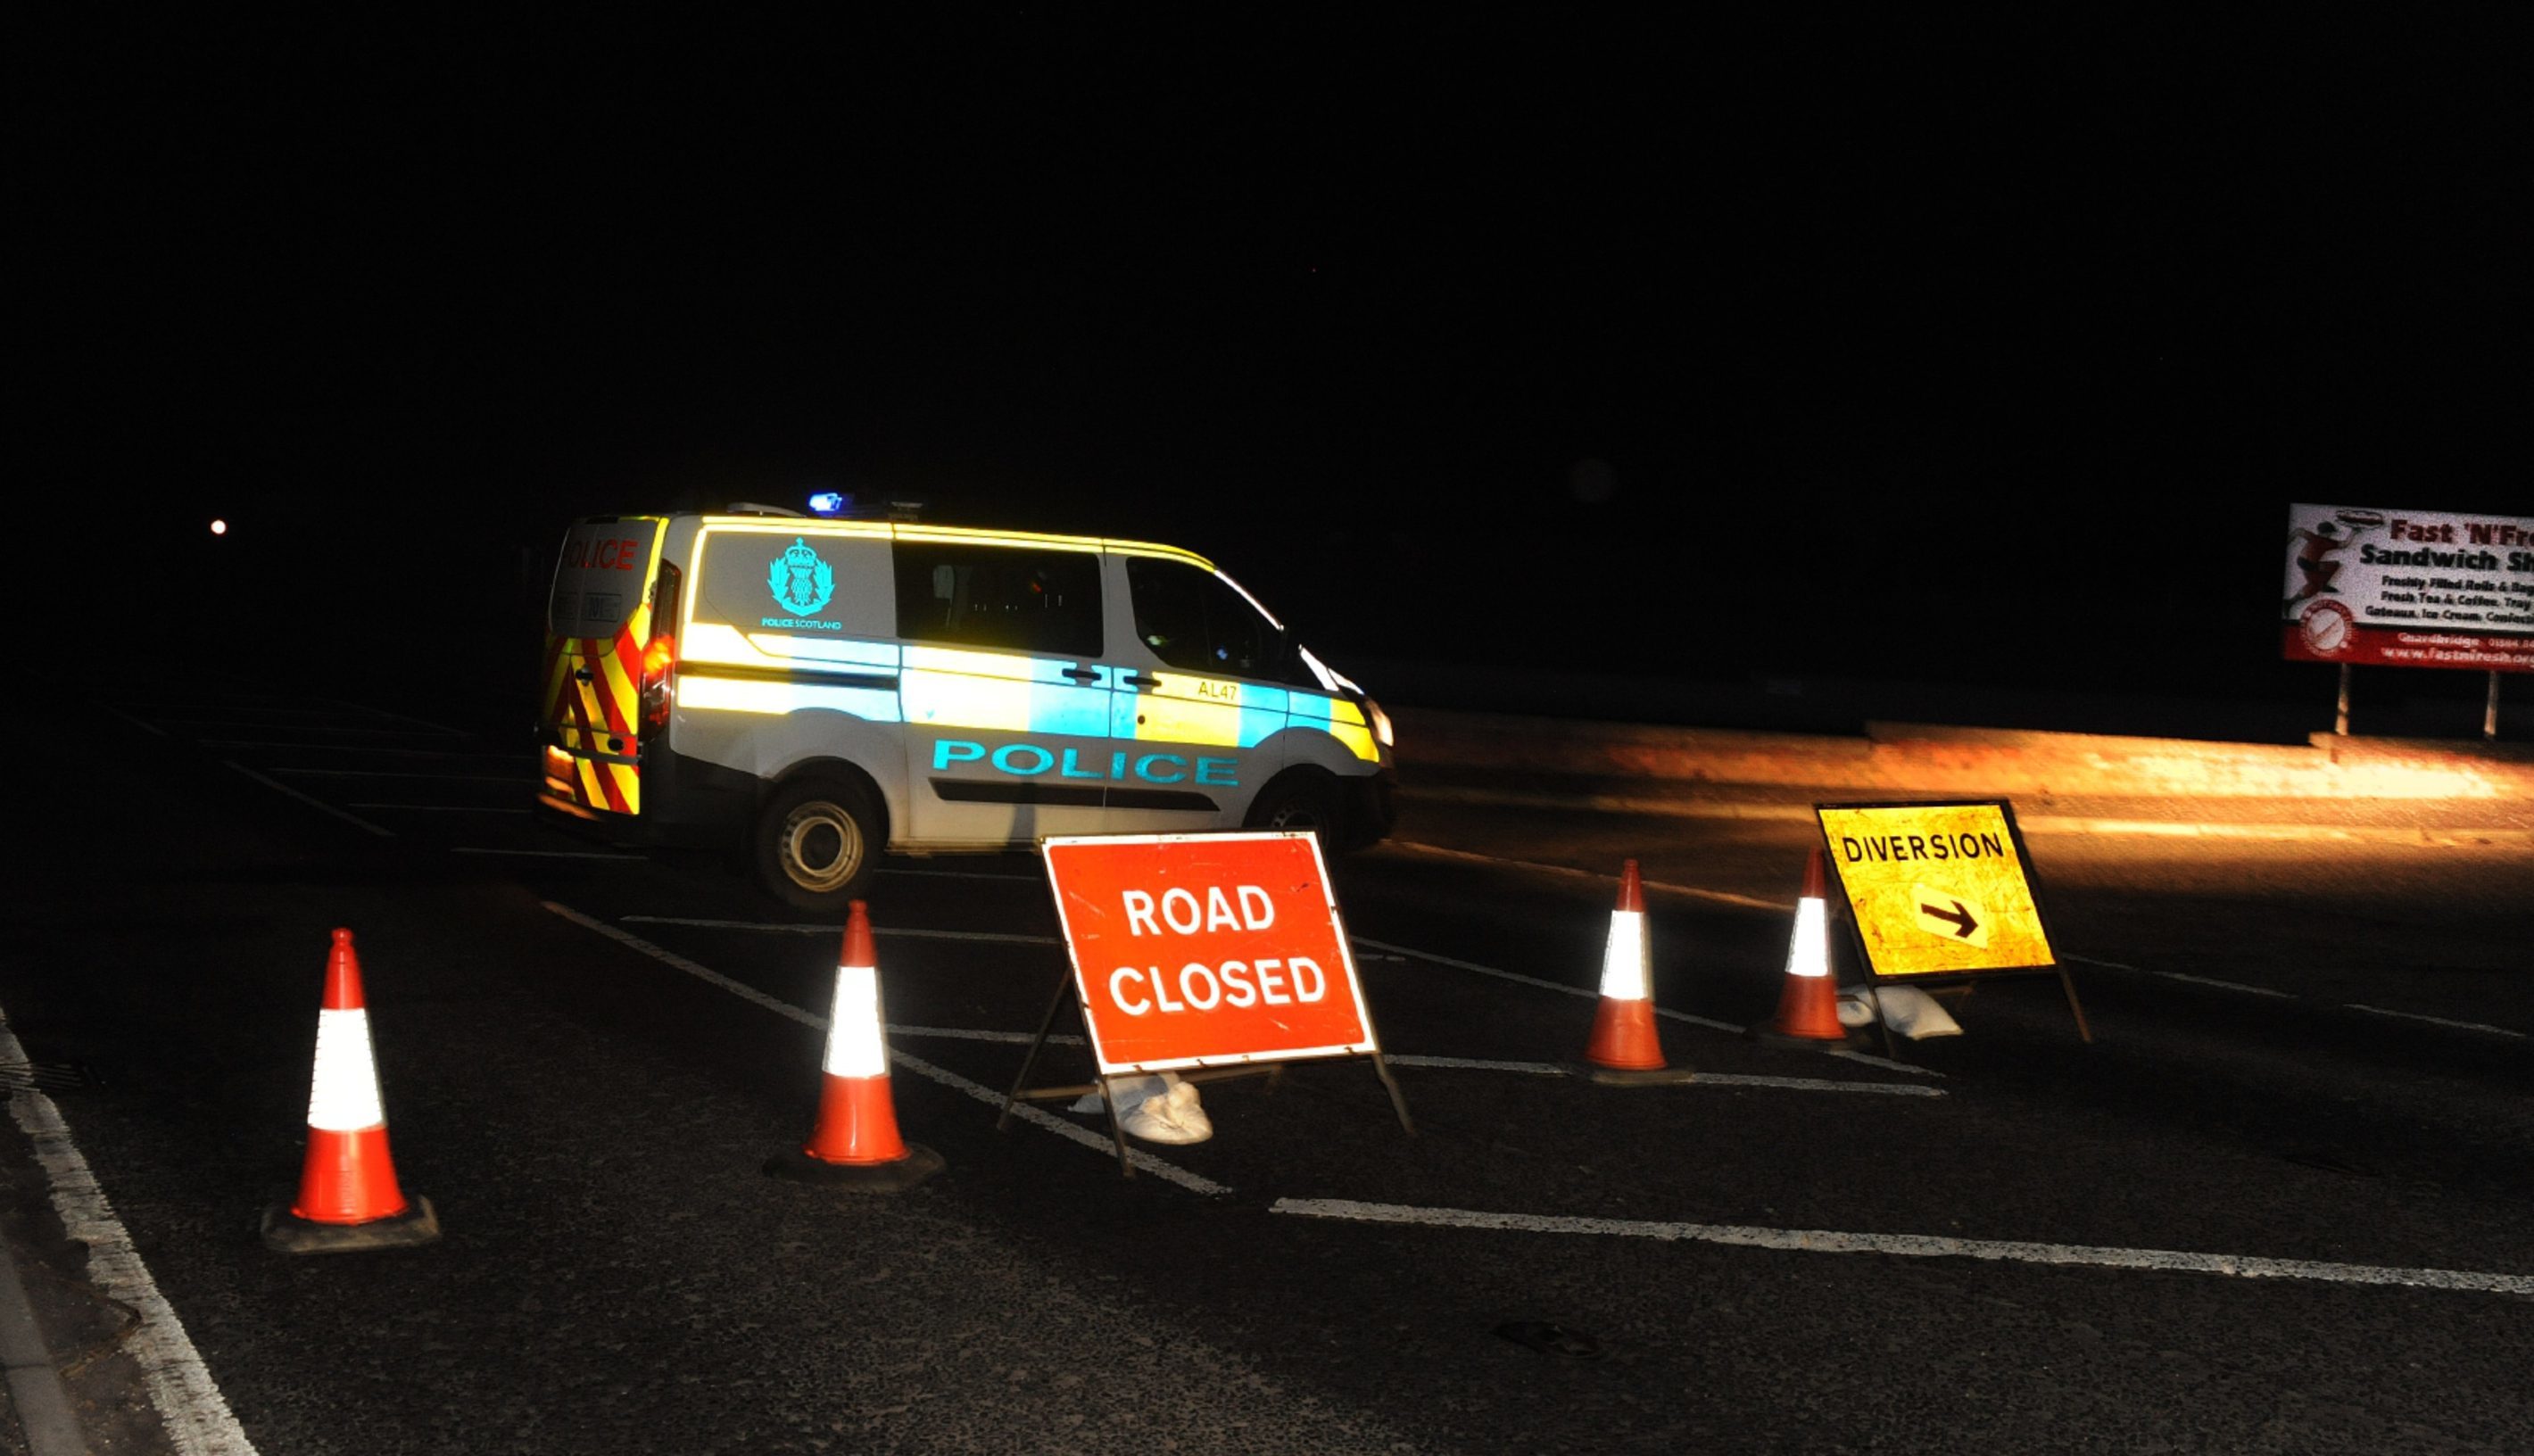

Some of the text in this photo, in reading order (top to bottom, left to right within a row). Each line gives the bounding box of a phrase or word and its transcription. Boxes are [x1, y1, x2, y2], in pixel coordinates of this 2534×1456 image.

[2390, 519, 2453, 543] Fast
[2360, 543, 2497, 570] Sandwich
[2381, 575, 2425, 590] Freshly
[2430, 578, 2462, 589] Filled
[2465, 580, 2494, 591] Rolls
[2498, 582, 2506, 592] &
[2381, 591, 2414, 602] Fresh
[2419, 592, 2440, 603] Tea
[2444, 593, 2454, 604] &
[2505, 597, 2530, 611] Tray
[762, 617, 842, 630] POLICE SCOTLAND
[2422, 608, 2439, 619] Ice
[1198, 681, 1237, 700] AL47
[932, 739, 1240, 788] POLICE
[1842, 831, 2005, 863] DIVERSION
[1122, 885, 1275, 937] ROAD
[1109, 956, 1326, 1015] CLOSED
